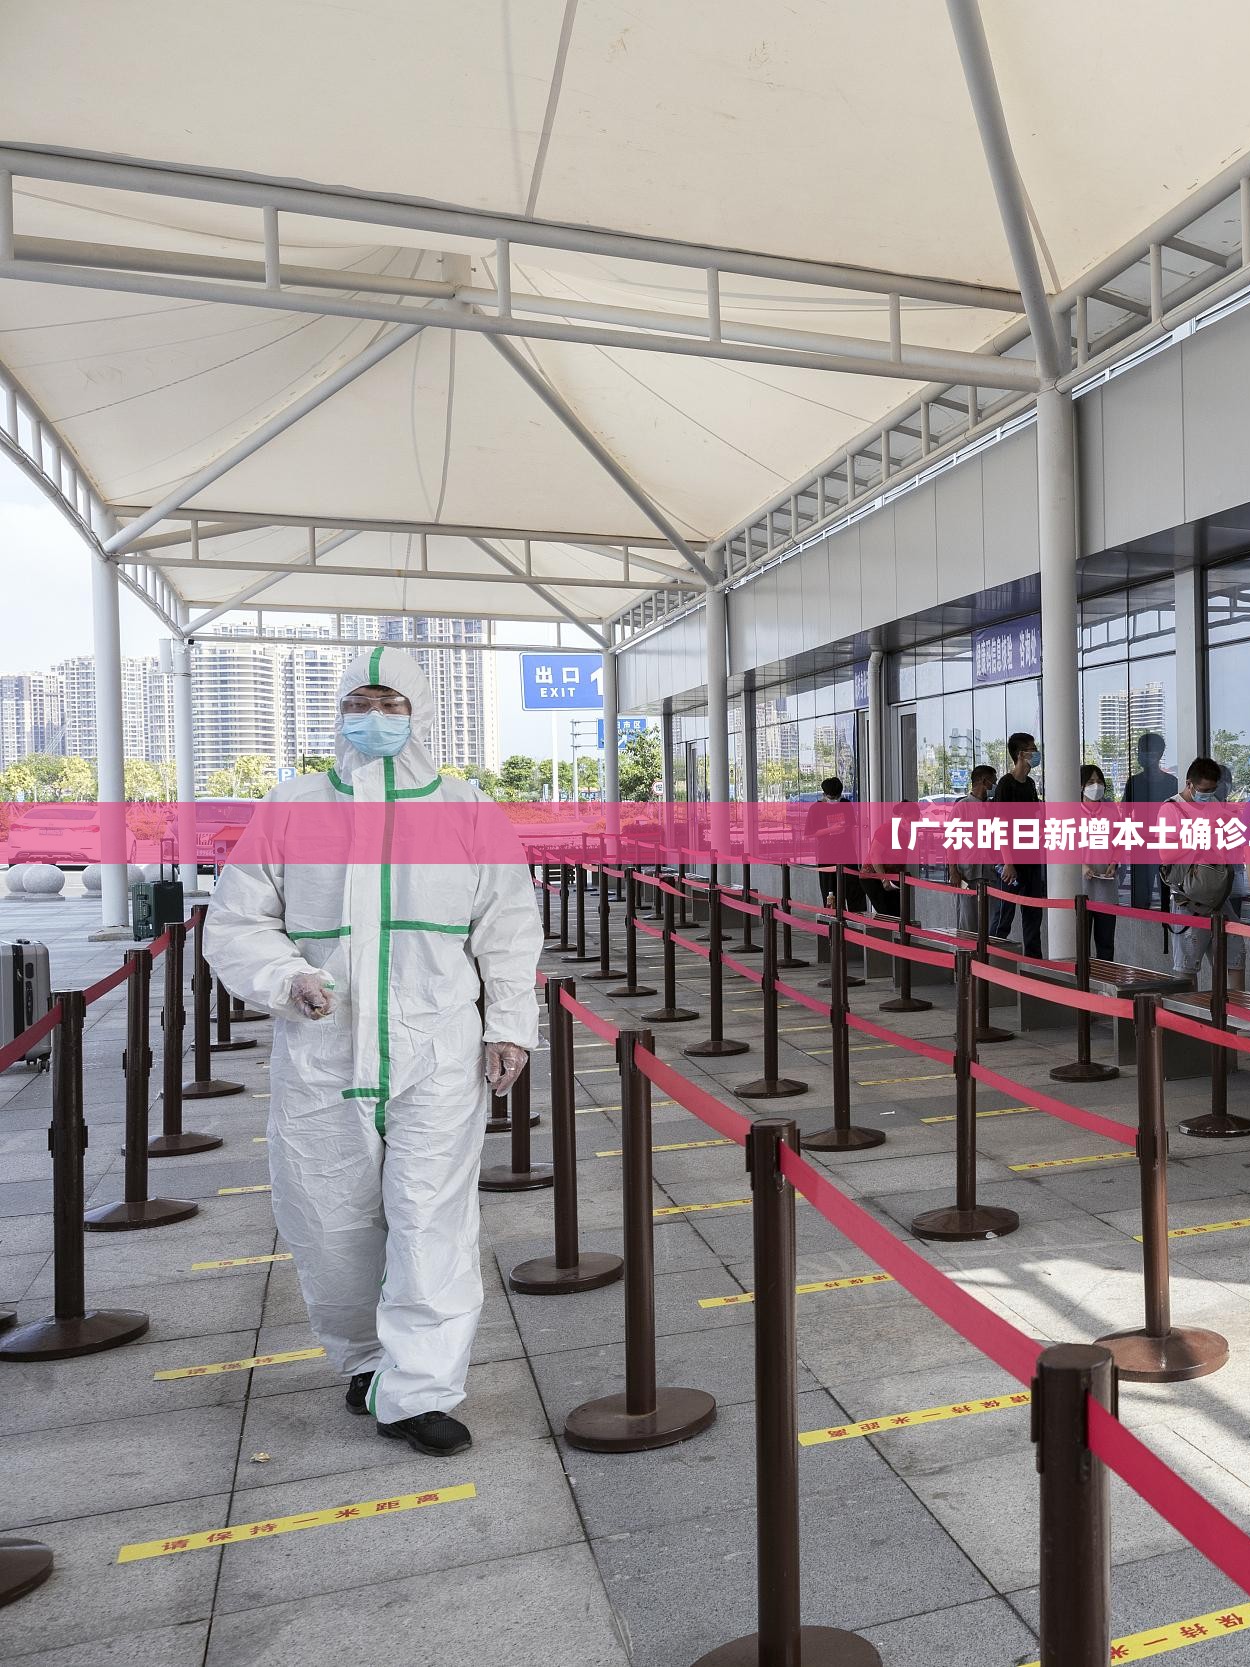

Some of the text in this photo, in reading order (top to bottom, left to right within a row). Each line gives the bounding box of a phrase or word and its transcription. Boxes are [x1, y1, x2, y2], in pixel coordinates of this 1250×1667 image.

[535, 665, 580, 684] 出口
[540, 687, 576, 698] EXIT
[828, 1394, 1030, 1438] 请保持一米距离
[162, 1493, 440, 1551] 请保持一米距离
